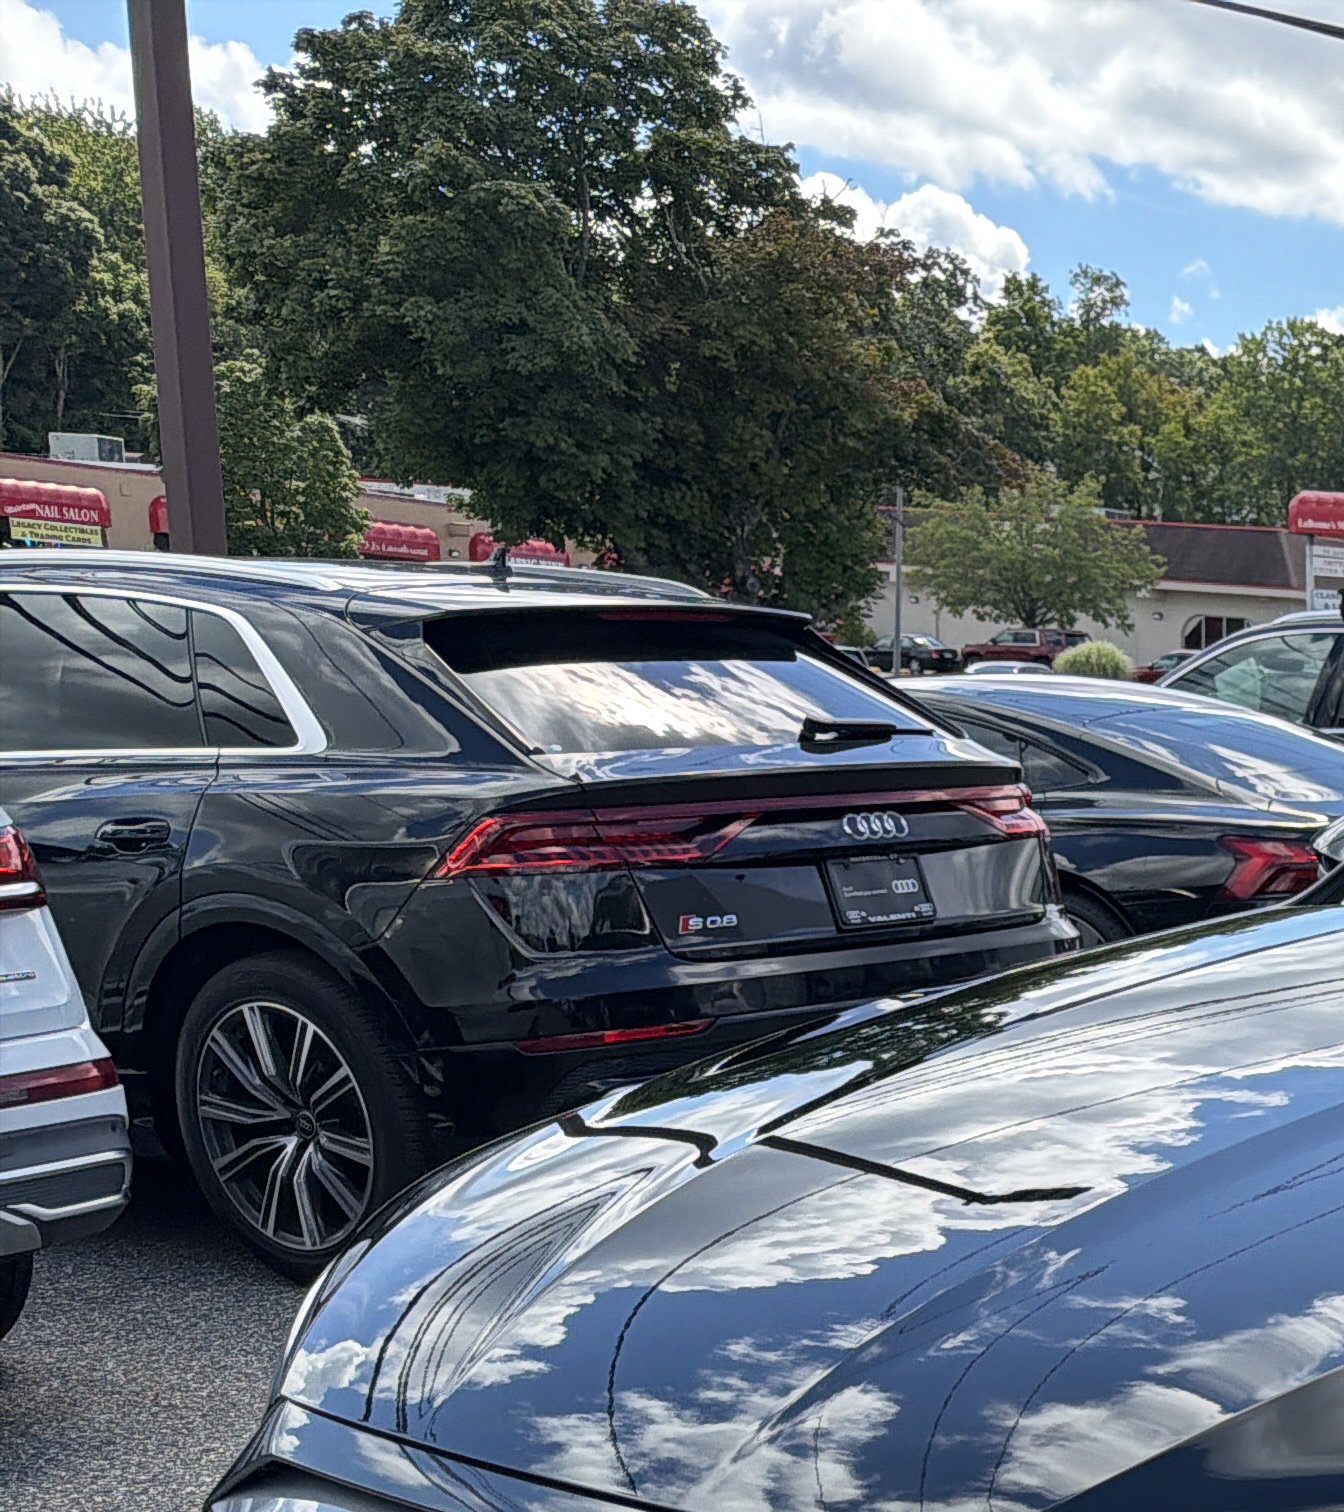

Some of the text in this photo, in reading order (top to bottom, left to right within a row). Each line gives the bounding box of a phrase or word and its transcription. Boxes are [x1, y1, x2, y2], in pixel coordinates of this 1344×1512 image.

[36, 504, 61, 519] NAIL
[63, 506, 99, 523] SALON
[11, 520, 42, 530] LEGACY
